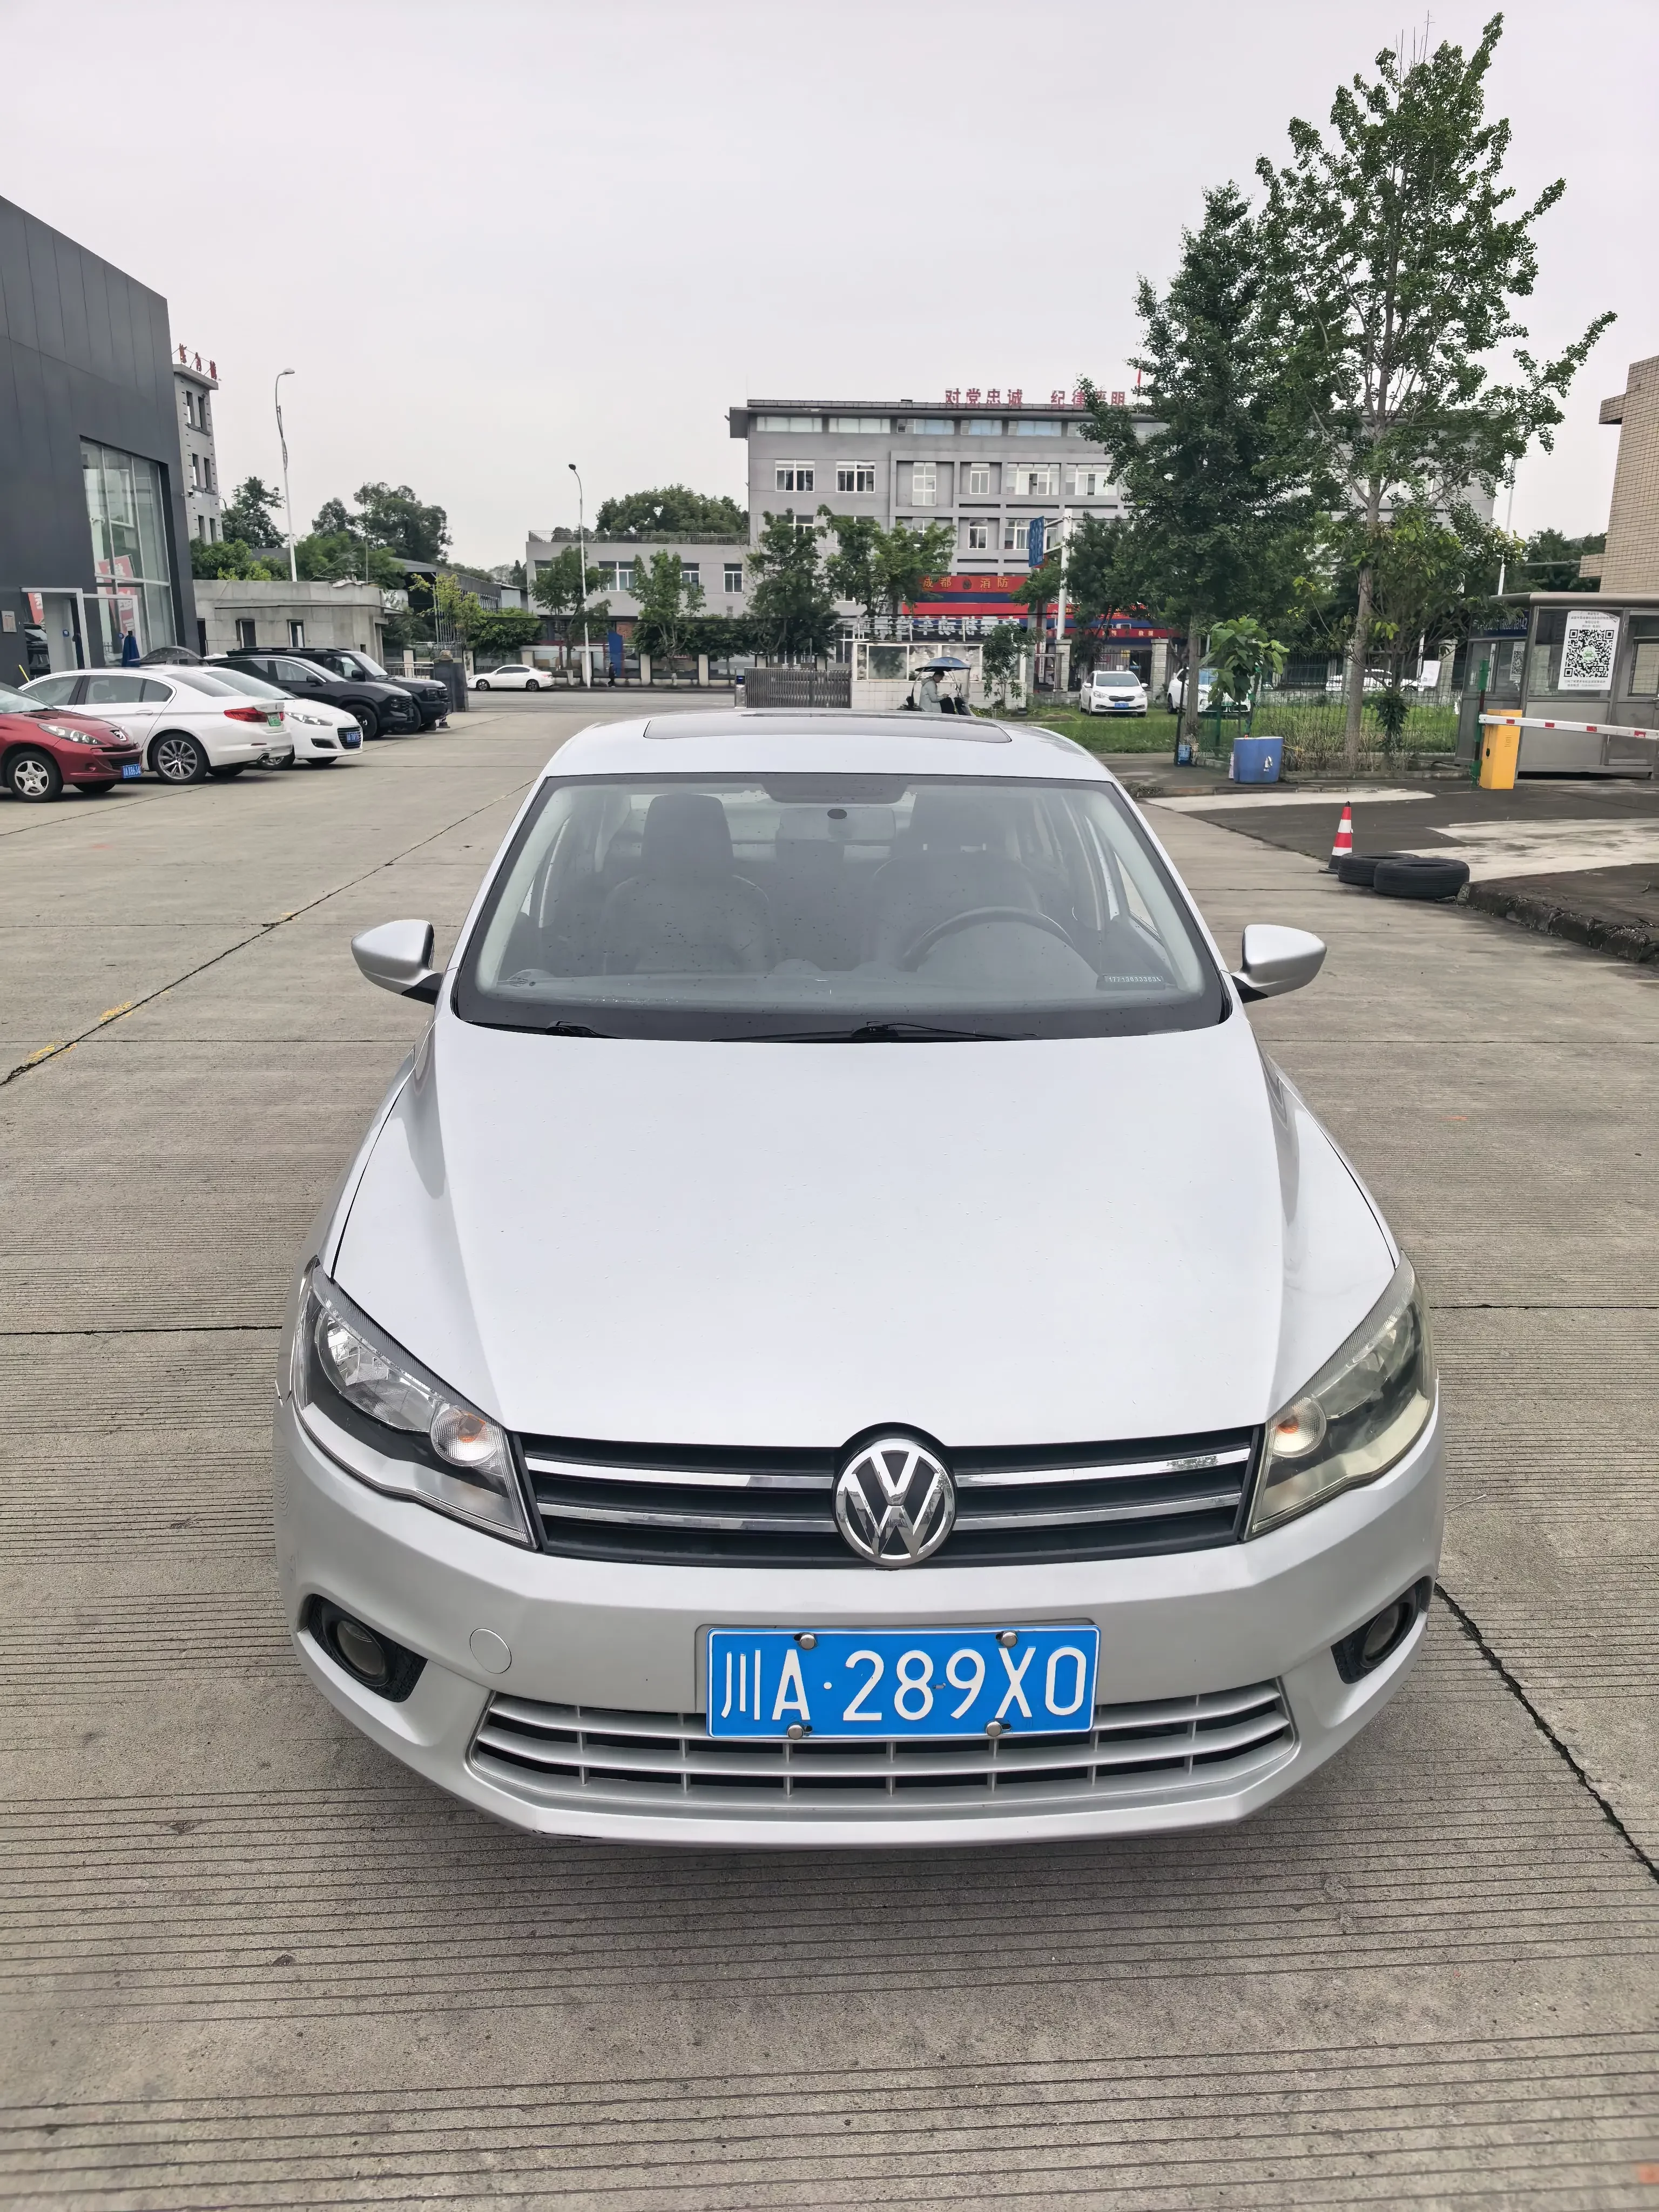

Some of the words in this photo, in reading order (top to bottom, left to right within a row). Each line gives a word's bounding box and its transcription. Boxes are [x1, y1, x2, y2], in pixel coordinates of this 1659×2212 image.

[945, 388, 1022, 404] 对党忠诚
[923, 577, 952, 588] 成都
[980, 577, 1009, 589] 消防
